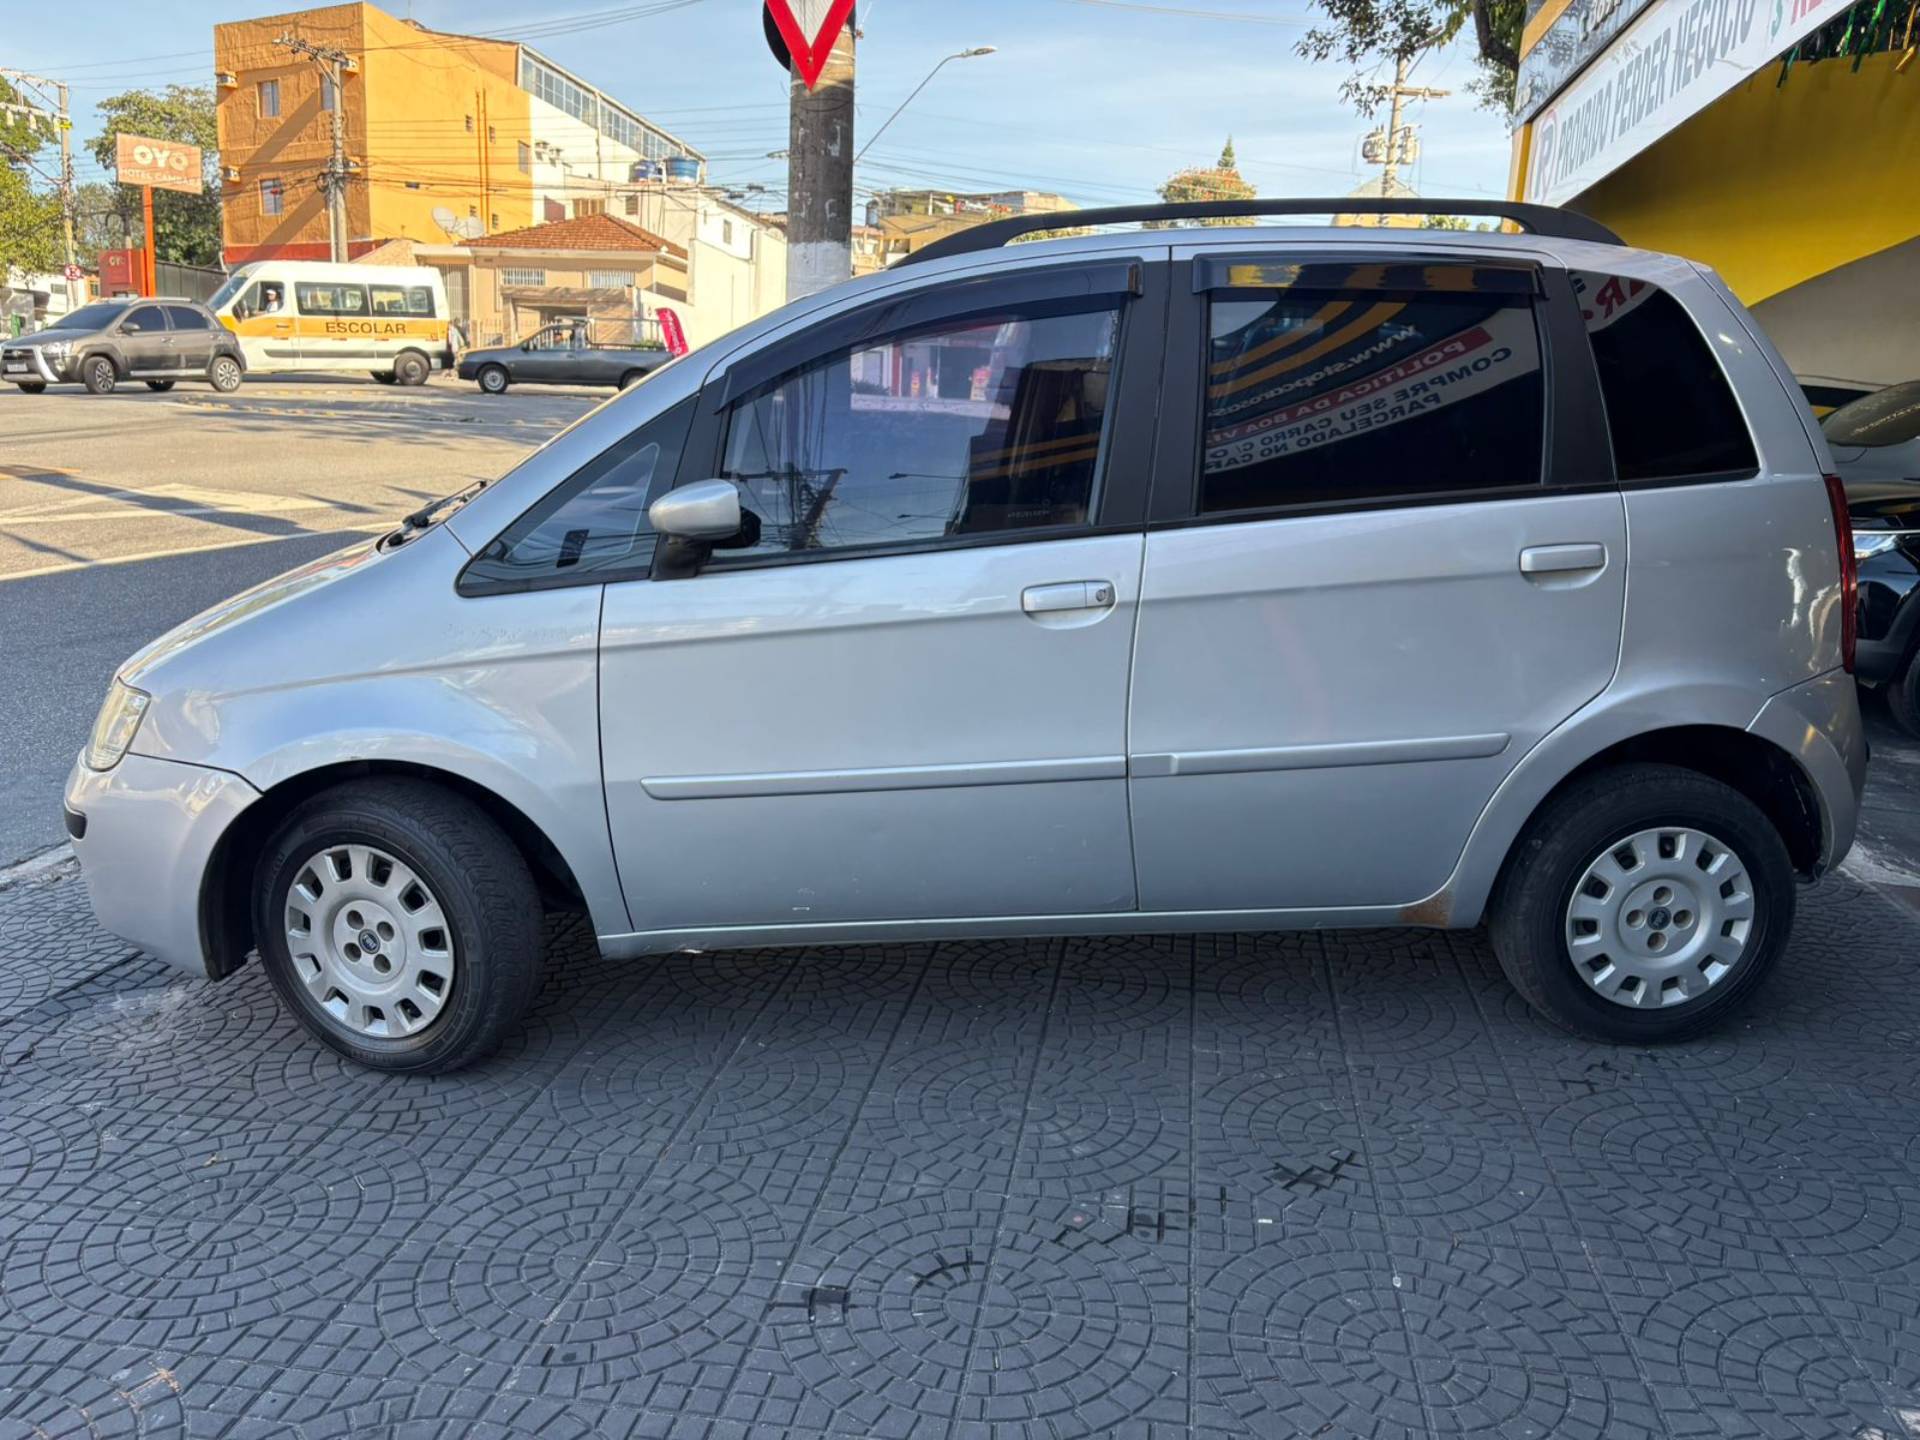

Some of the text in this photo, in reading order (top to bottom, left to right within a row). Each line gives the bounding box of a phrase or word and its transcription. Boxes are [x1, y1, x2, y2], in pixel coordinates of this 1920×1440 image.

[1554, 80, 1612, 185] PROIBIDO
[1610, 27, 1672, 144] PERDER
[133, 145, 189, 171] OYO
[325, 321, 407, 335] ESCOLAR
